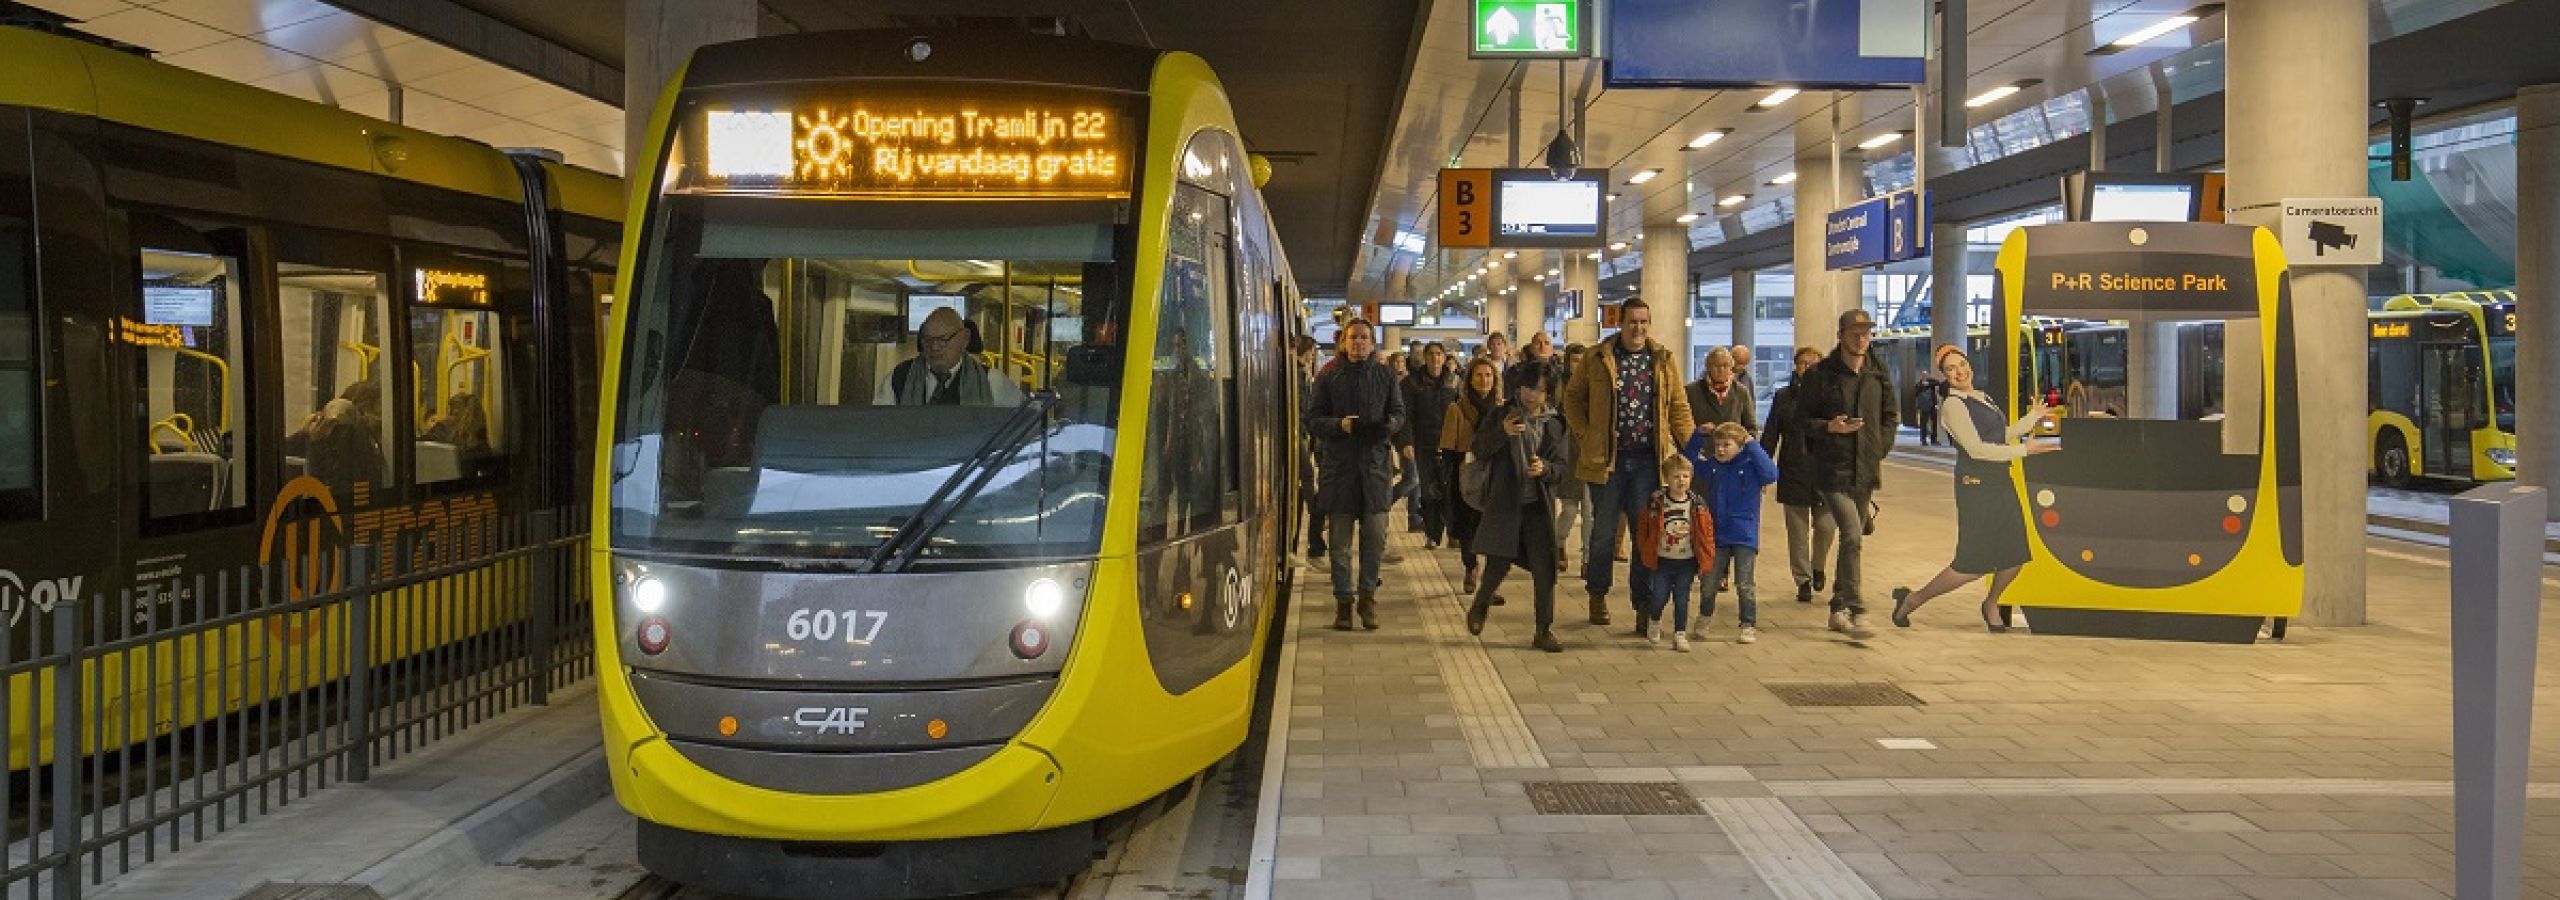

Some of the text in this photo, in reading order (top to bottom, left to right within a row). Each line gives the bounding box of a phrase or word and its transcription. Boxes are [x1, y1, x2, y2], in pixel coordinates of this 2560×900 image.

[853, 109, 1105, 145] Opening Tramlijn 22
[874, 147, 1116, 181] Rij vandaag gratis
[1456, 180, 1475, 206] B
[1458, 210, 1473, 236] 3
[2286, 206, 2379, 217] Cameratoezicht
[1893, 217, 1904, 253] B
[2051, 272, 2228, 291] P+R Science Park
[786, 608, 889, 642] 6017
[793, 707, 869, 734] CAF
